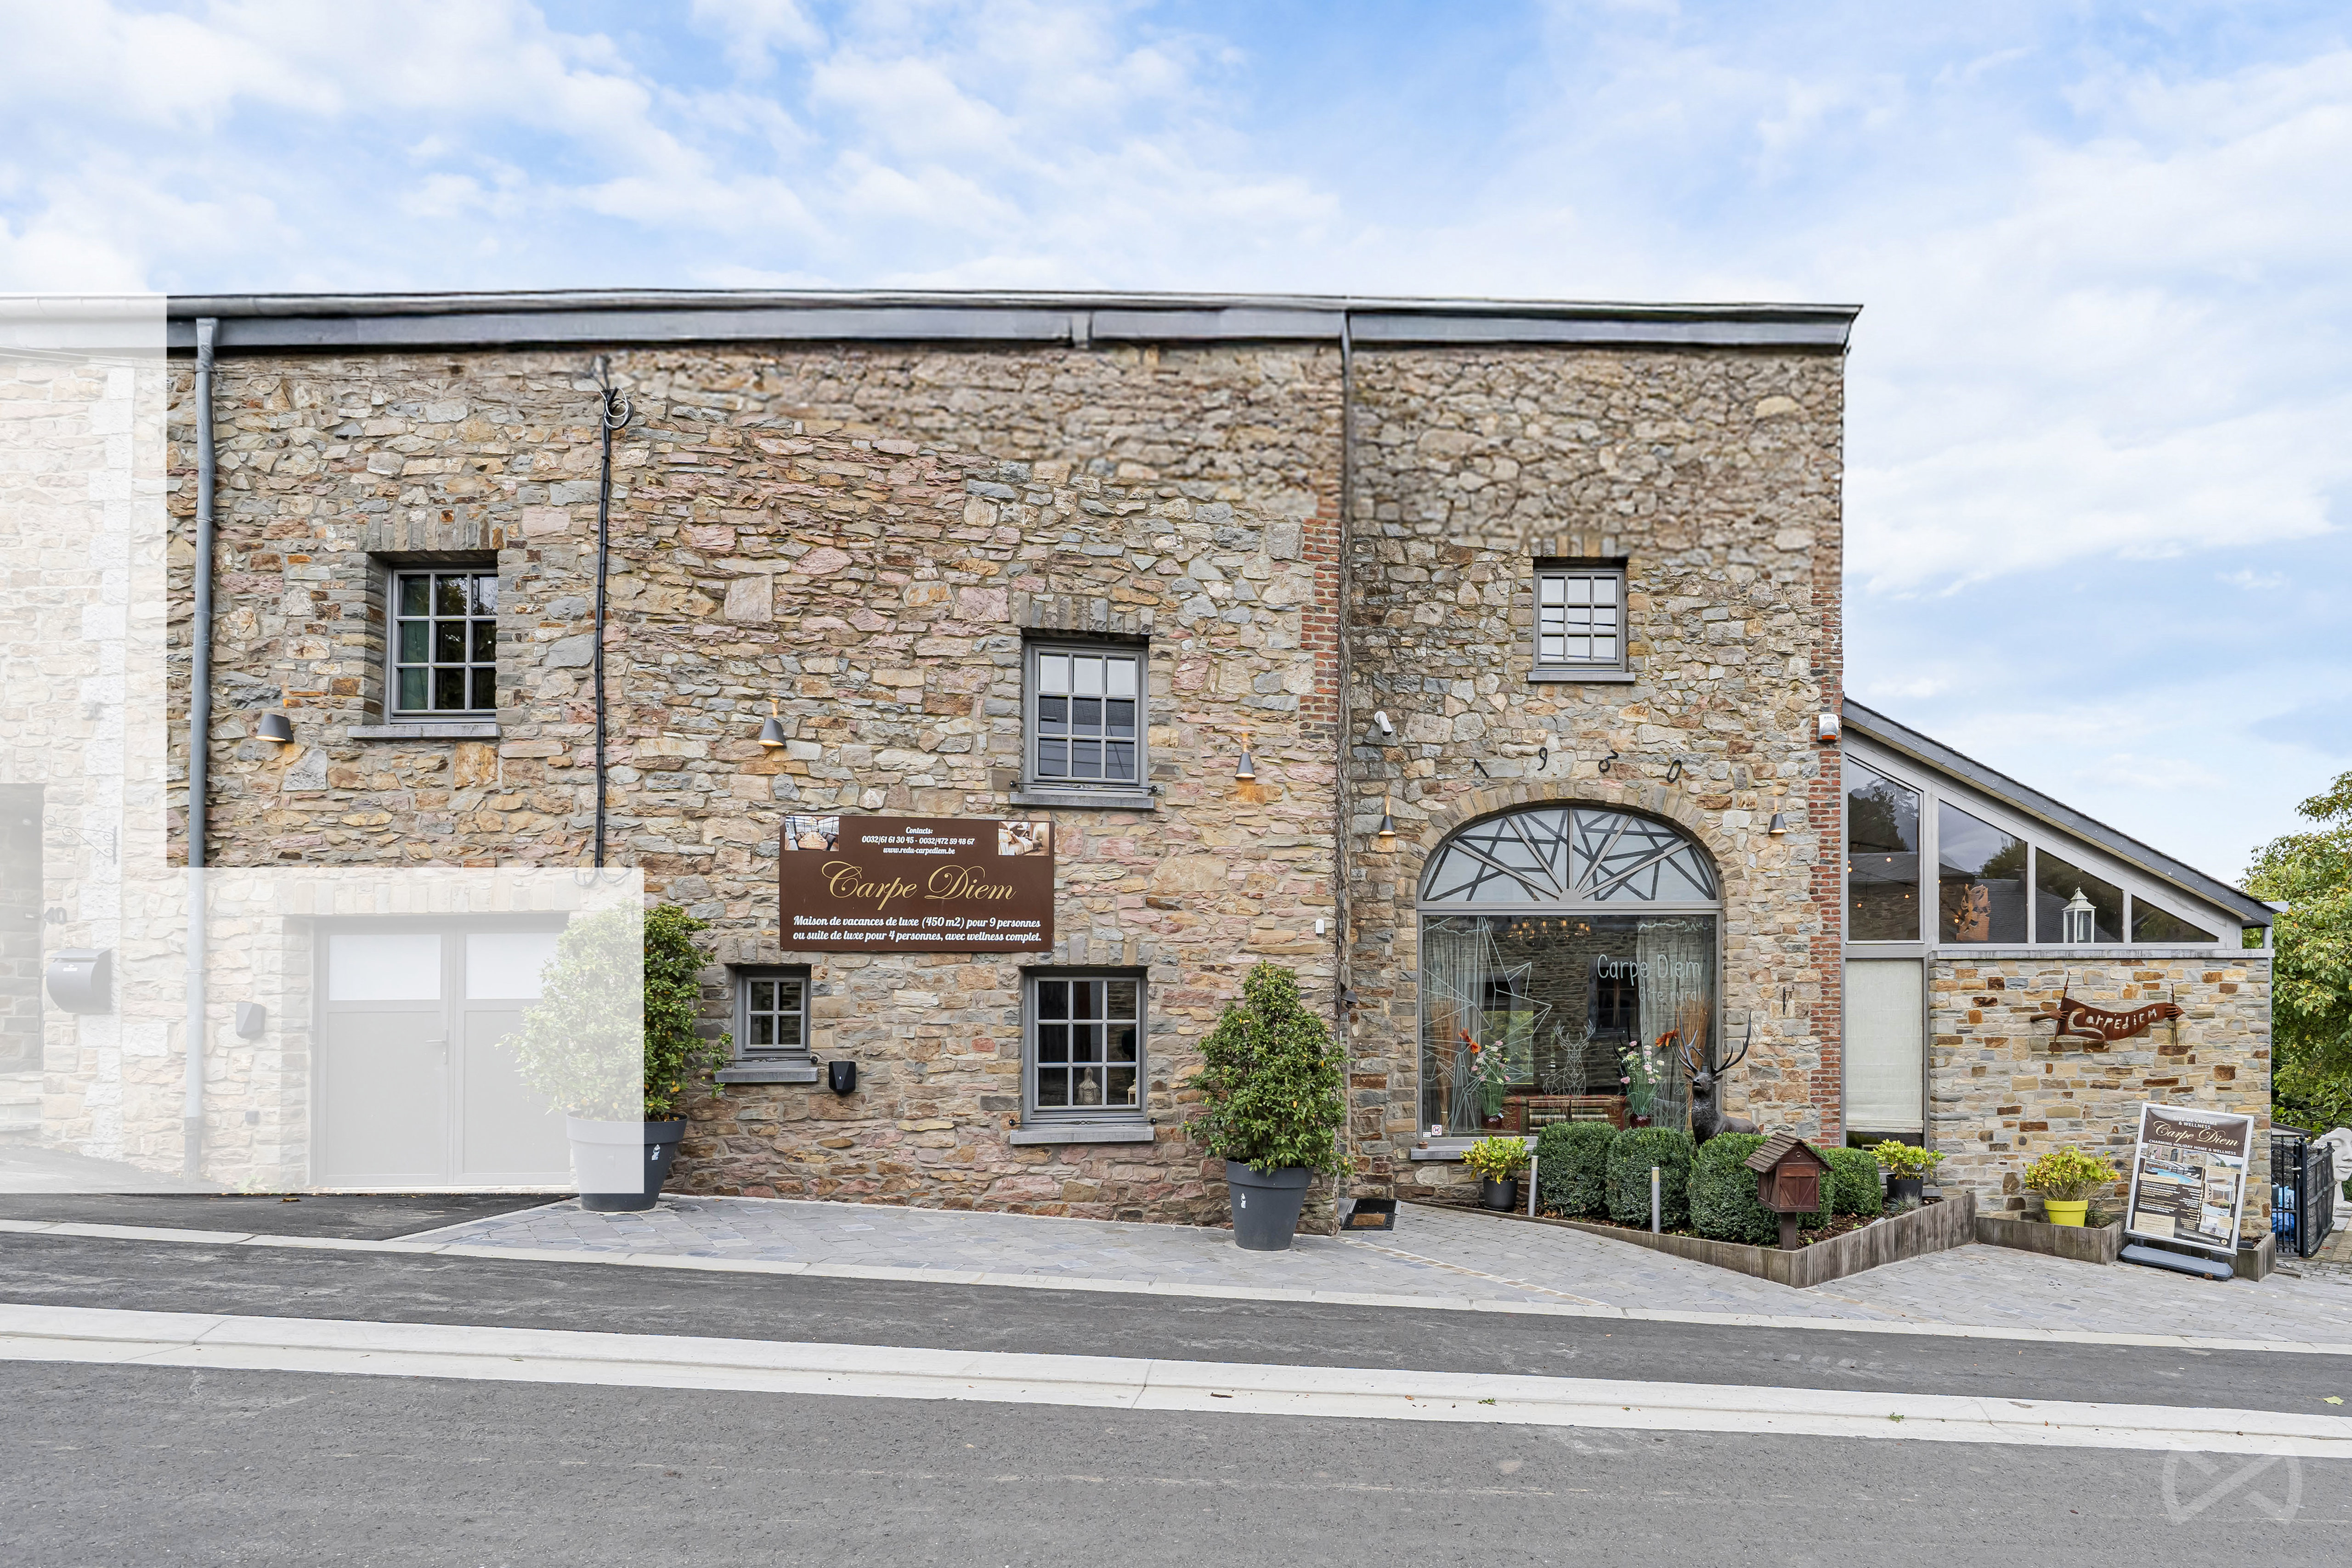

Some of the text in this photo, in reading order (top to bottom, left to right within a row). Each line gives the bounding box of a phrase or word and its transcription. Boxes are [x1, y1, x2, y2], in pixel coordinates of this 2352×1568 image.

[861, 835, 887, 845] 0032/61
[919, 838, 948, 846] 0032/472
[883, 847, 956, 855] www.redu-carpediem.be
[821, 860, 1017, 911] Carpe Diem
[793, 916, 828, 926] Maison
[829, 917, 842, 926] de
[885, 917, 898, 926] de
[898, 917, 919, 926] luxe
[922, 917, 944, 929] (450
[945, 917, 965, 929] m2)
[966, 918, 988, 929] pour
[989, 917, 996, 927] 9
[996, 920, 1041, 930] personnes
[806, 930, 829, 940] suite
[830, 931, 842, 940] de
[843, 931, 864, 940] luxe
[864, 933, 887, 943] pour
[888, 930, 896, 940] 4
[895, 933, 944, 943] personnes,
[967, 932, 1004, 941] wellness
[1005, 932, 1042, 944] complet.
[1597, 954, 1701, 986] Carpe Diem
[1670, 986, 1702, 1002] rural
[2153, 1121, 2240, 1147] Carpe Diem
